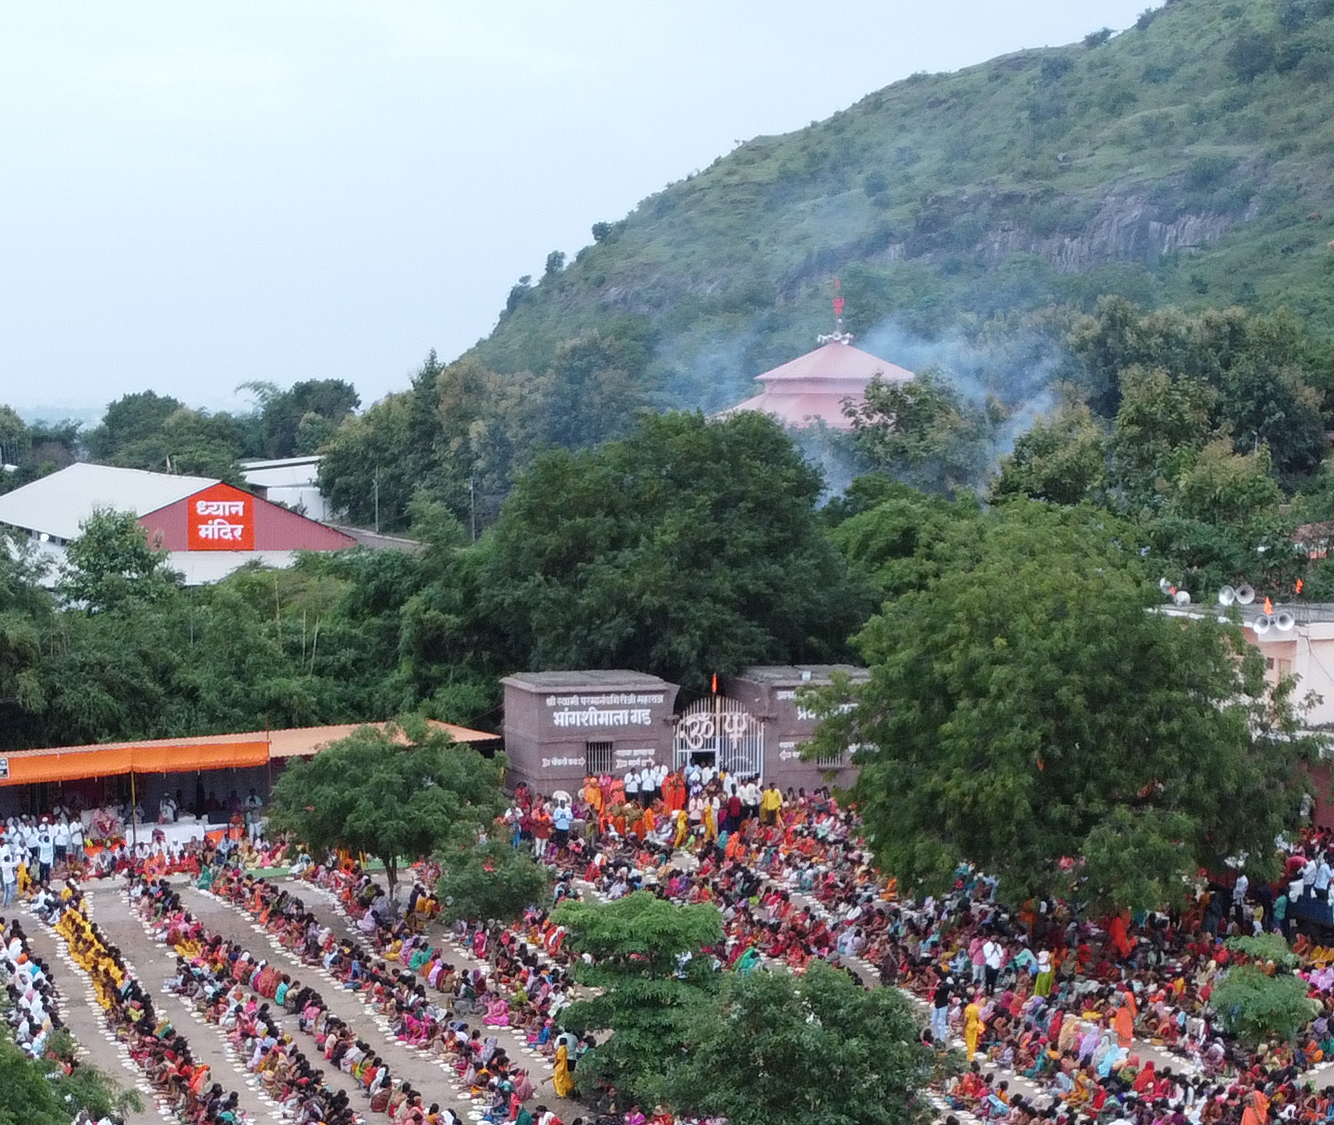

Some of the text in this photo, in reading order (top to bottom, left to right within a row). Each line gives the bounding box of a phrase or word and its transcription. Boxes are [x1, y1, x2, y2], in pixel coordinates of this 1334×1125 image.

[196, 500, 245, 517] ध्यान
[198, 518, 245, 541] मंदिर
[546, 695, 556, 706] श्री
[553, 706, 652, 727] भांगशीमाता गड
